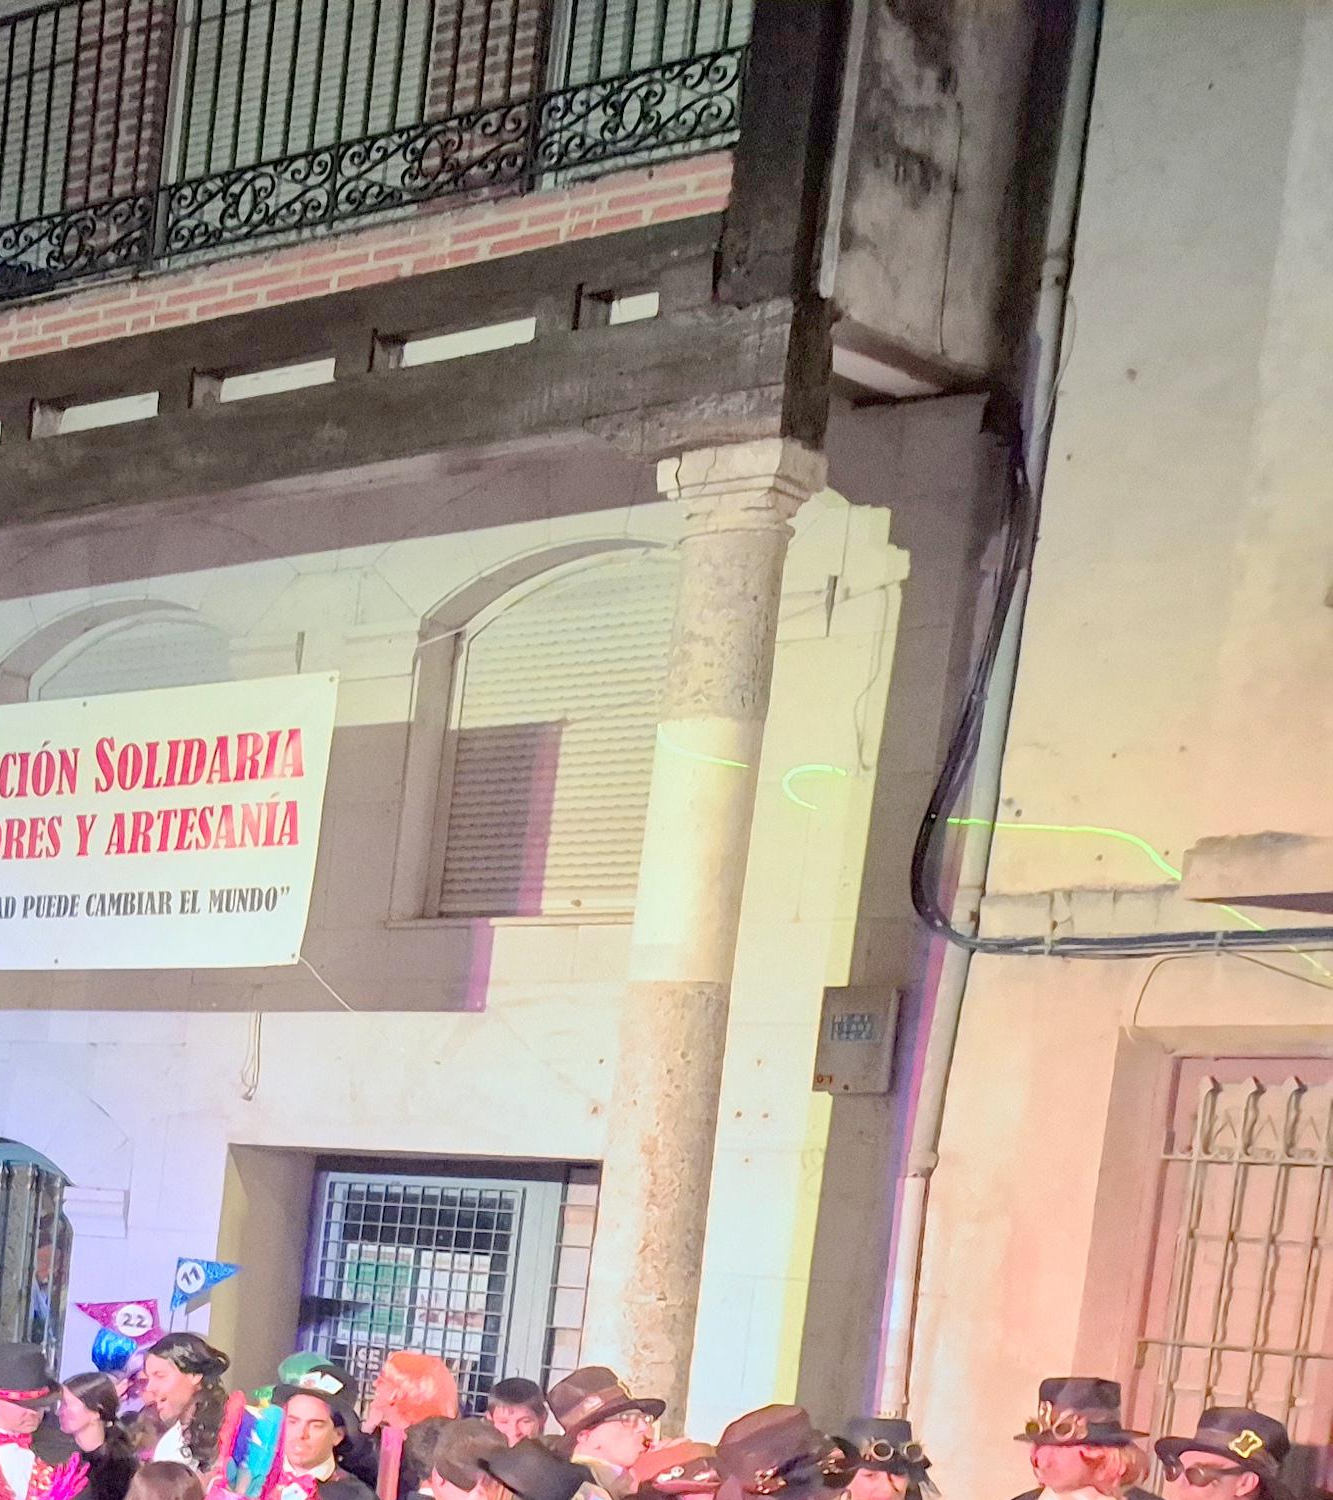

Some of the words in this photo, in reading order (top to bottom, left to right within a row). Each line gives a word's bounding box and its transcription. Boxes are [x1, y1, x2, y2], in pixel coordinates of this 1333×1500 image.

[95, 728, 304, 793] SOLIDARIA
[76, 814, 98, 857] Y
[105, 792, 300, 856] ARTESANÍA
[22, 893, 81, 920] PUEDE
[85, 890, 173, 918] CAMBIAR
[179, 889, 201, 915] EL
[180, 1265, 202, 1287] 11
[122, 1312, 148, 1329] 22
